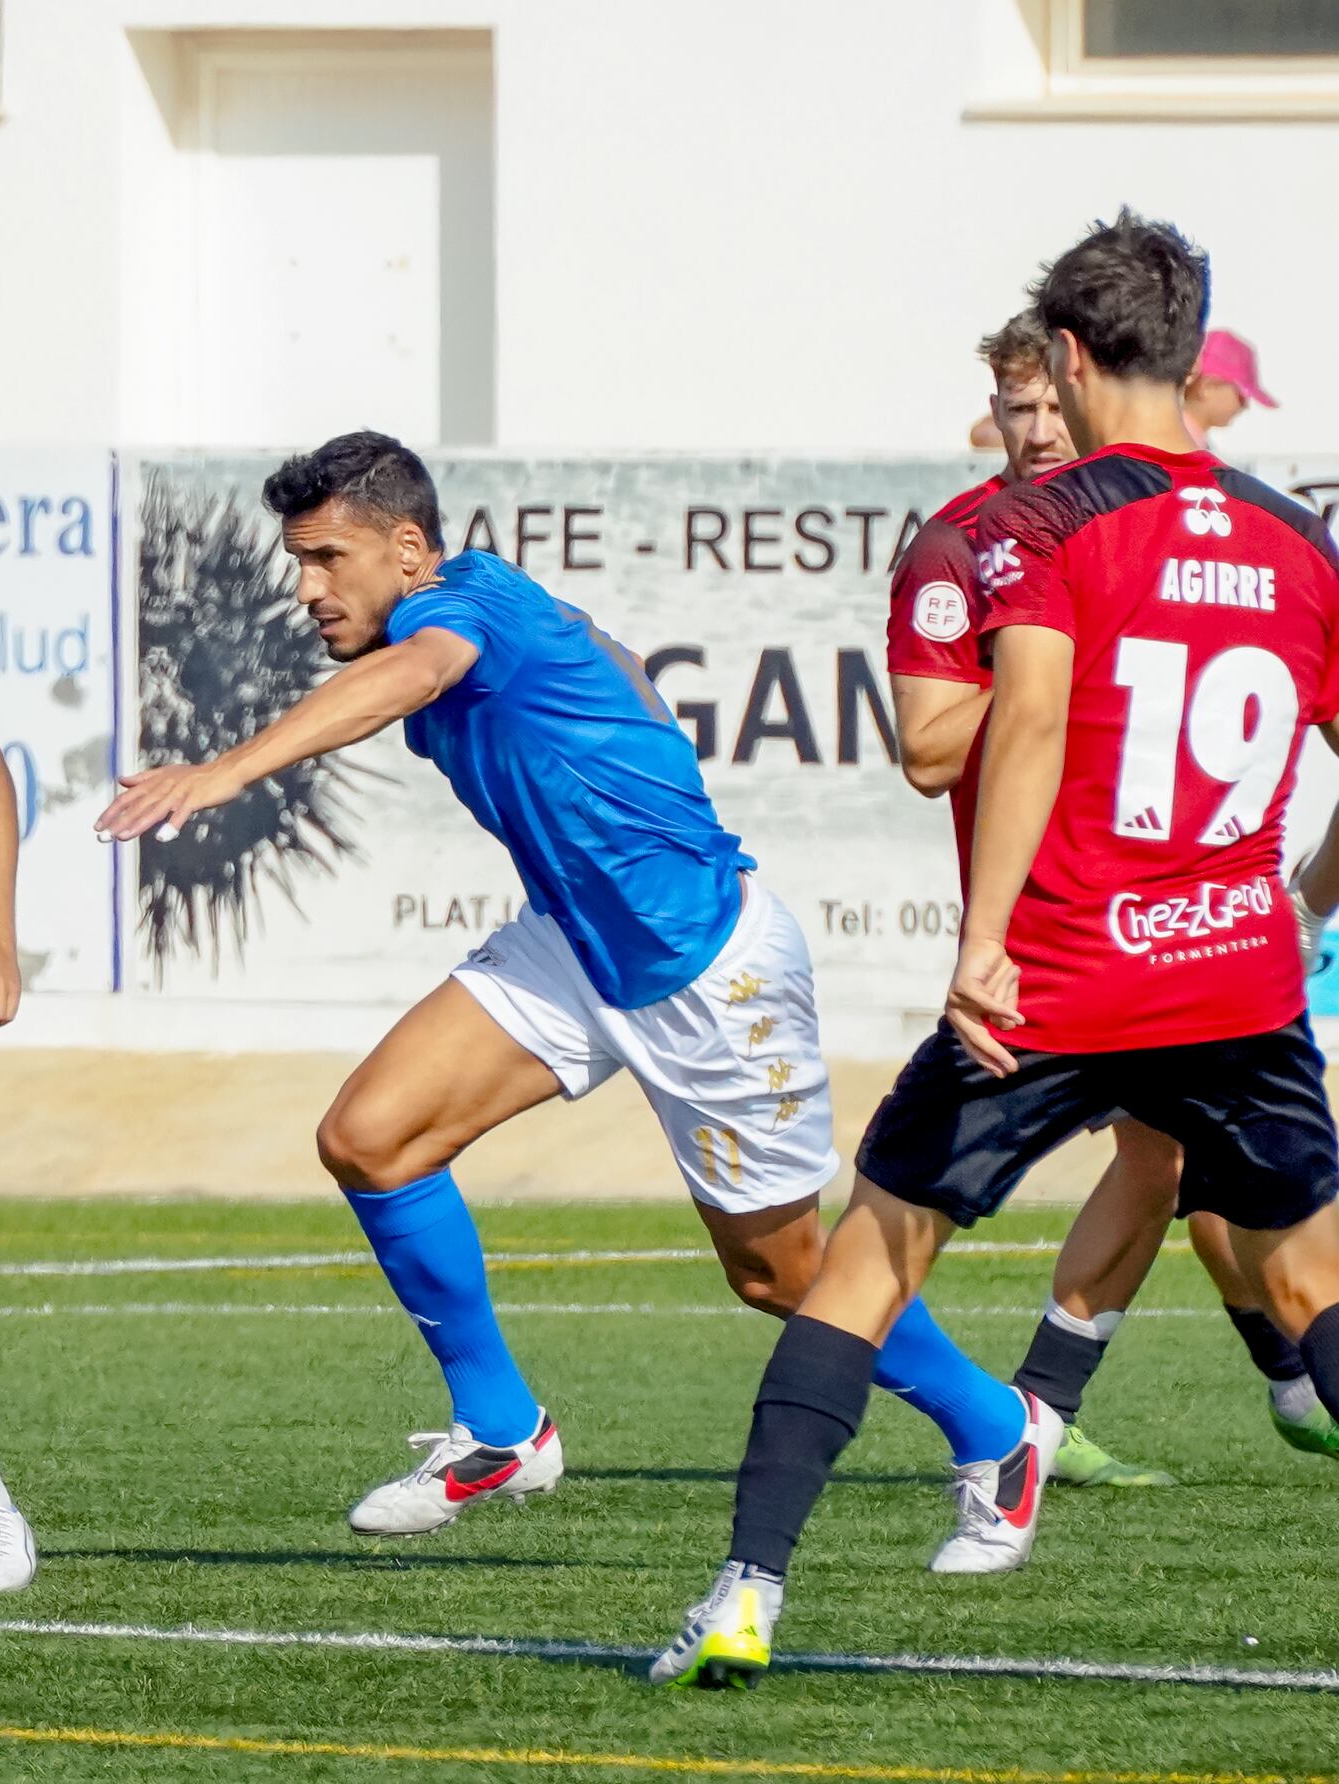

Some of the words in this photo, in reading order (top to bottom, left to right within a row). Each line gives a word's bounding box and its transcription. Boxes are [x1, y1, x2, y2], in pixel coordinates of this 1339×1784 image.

[439, 506, 603, 569] AFE
[1160, 557, 1276, 611] AGIRRE
[1113, 636, 1299, 845] 19
[818, 900, 884, 936] Tel:
[1150, 935, 1269, 965] FORMENTERA
[693, 1126, 743, 1185] 11
